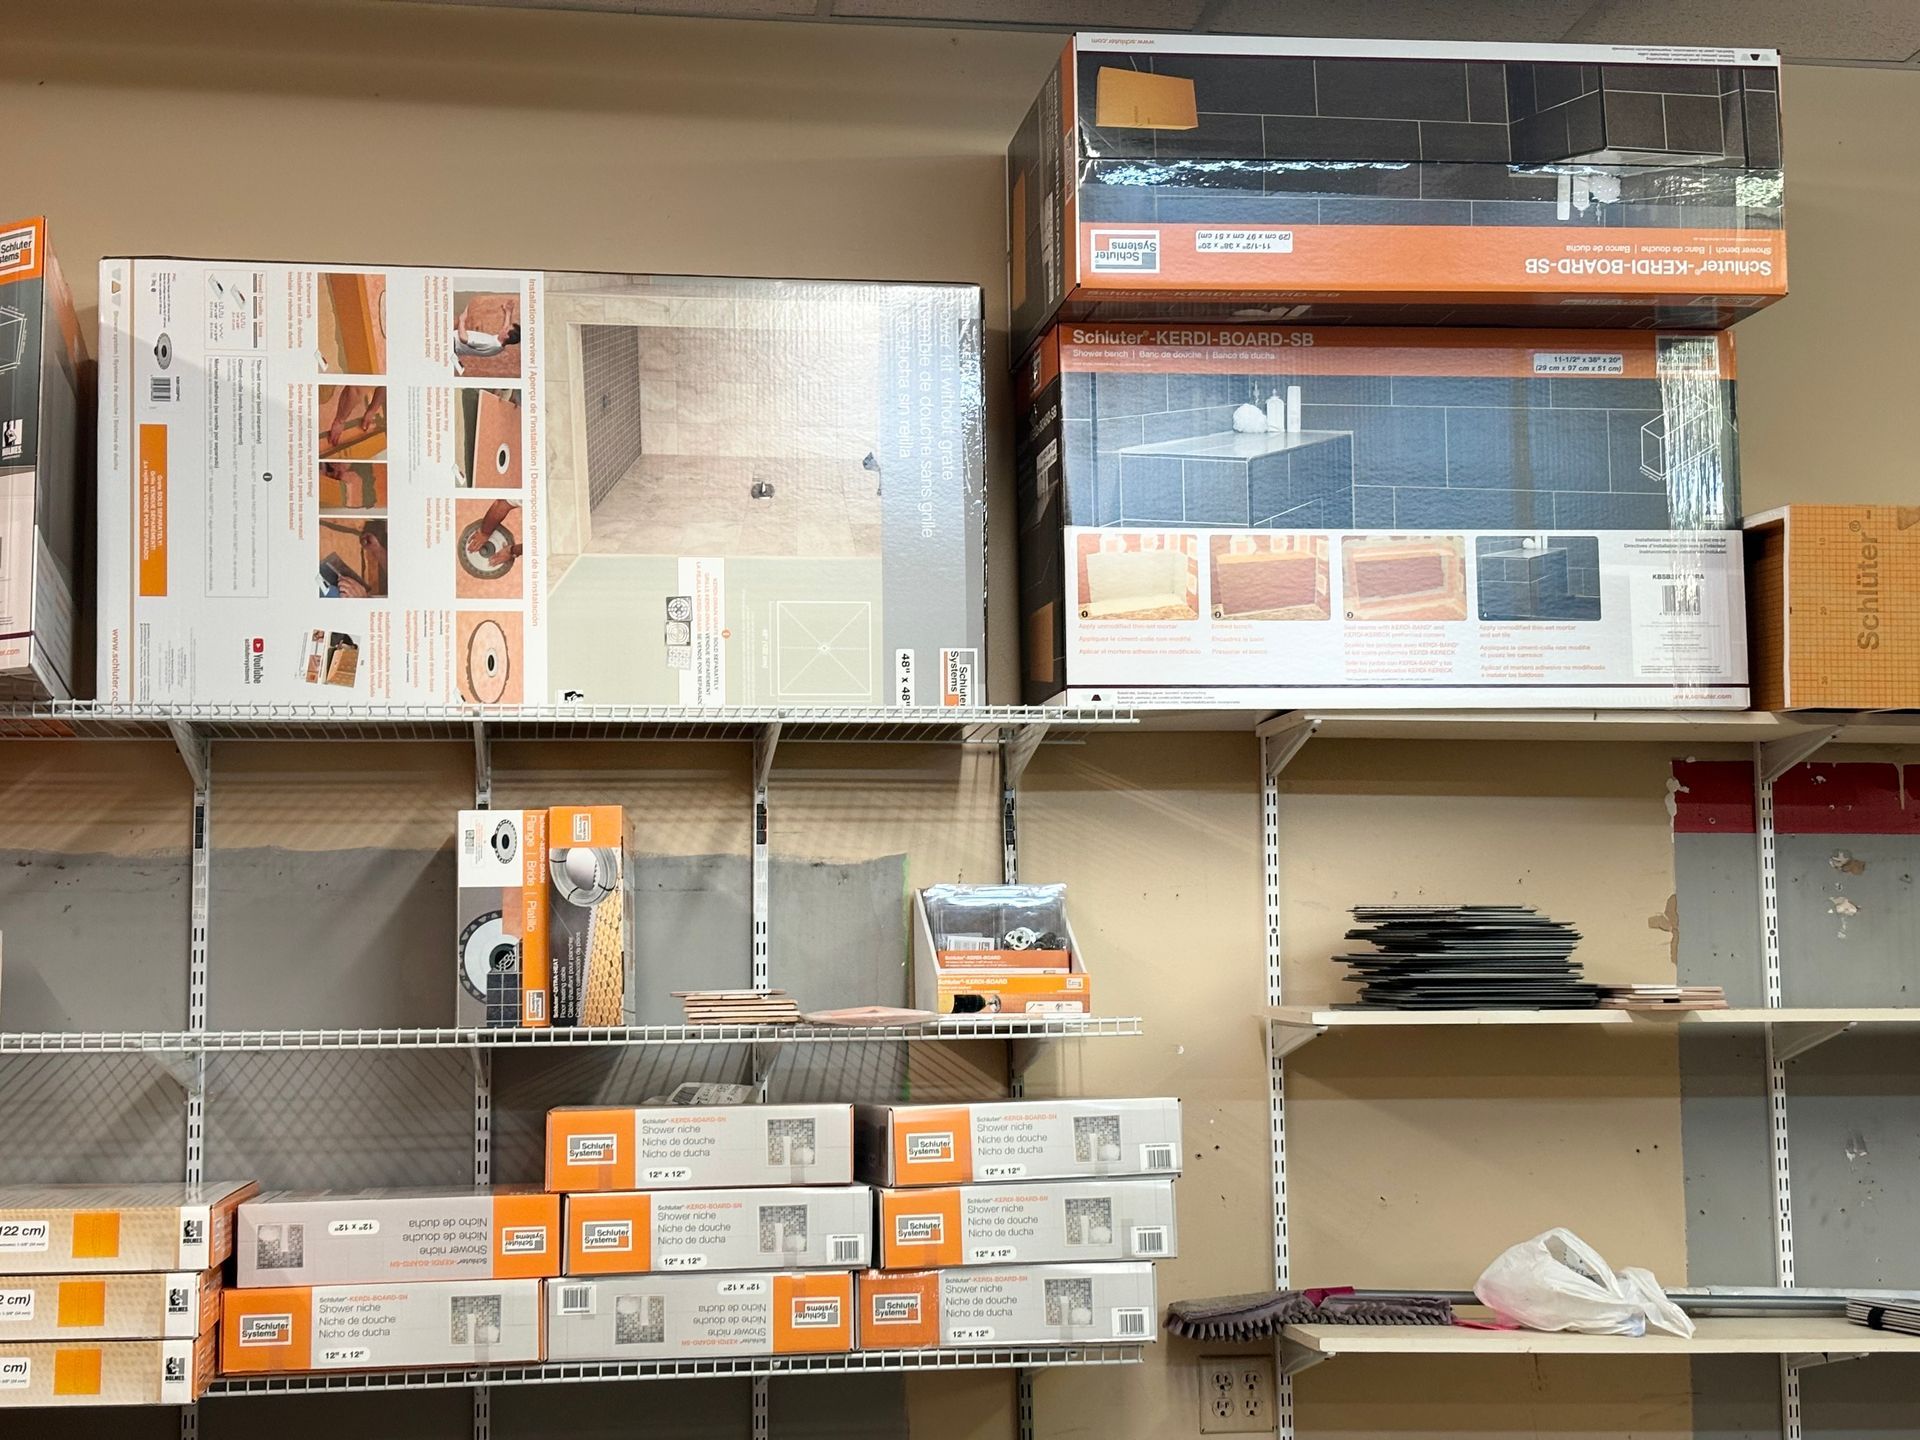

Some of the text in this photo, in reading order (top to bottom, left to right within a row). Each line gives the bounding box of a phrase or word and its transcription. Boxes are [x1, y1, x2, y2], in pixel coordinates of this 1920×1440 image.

[1090, 38, 1155, 47] www.schluter.com
[1198, 232, 1213, 240] cm)
[1, 241, 32, 253] Schluter
[1112, 241, 1156, 251] Systems
[1219, 242, 1234, 250] 38"
[1242, 242, 1271, 250] 11-1/2"
[1566, 245, 1591, 253] ducha
[1593, 245, 1603, 253] de
[1604, 245, 1630, 253] Banco
[1716, 246, 1740, 254] bench
[1741, 246, 1772, 255] Shower
[1095, 251, 1140, 261] Schluter
[1073, 350, 1102, 359] Shower
[1105, 350, 1128, 359] bench
[1139, 351, 1160, 359] Banc
[1161, 351, 1172, 359] de
[1173, 351, 1201, 359] douche
[1250, 352, 1275, 360] ducha
[899, 341, 913, 388] ducha
[940, 355, 957, 371] kit
[920, 371, 934, 391] de
[899, 394, 912, 415] sin
[941, 379, 956, 435] without
[920, 396, 933, 455] douche
[897, 421, 914, 458] rejilla
[528, 279, 539, 626] Installation overview Aperçu de l'installation Descripción general de la instalación
[936, 440, 956, 480] grate
[921, 460, 934, 497] sans
[917, 503, 935, 538] grille
[902, 653, 910, 674] 48"
[253, 654, 263, 684] YouTube
[950, 651, 959, 692] Systems
[525, 815, 537, 932] Flange Bride Platillo
[642, 1125, 700, 1134] Shower niche
[977, 1122, 1033, 1132] Shower niche
[642, 1136, 715, 1146] Niche de douche
[977, 1134, 1047, 1143] Niche de douche
[920, 1140, 950, 1148] Schluter
[569, 1150, 601, 1158] Systems
[642, 1149, 710, 1158] Nicho de ducha
[909, 1147, 940, 1156] Systems
[978, 1145, 1043, 1155] Nicho de ducha
[672, 1170, 685, 1178] 12"
[985, 1167, 999, 1175] 12"
[334, 1223, 349, 1232] 12"
[358, 1223, 373, 1231] 12"
[409, 1218, 487, 1230] Nicho de ducha
[910, 1222, 941, 1230] Schluter
[22, 1225, 45, 1238] cm)
[597, 1228, 629, 1236] Schluter
[898, 1229, 929, 1237] Systems
[402, 1232, 487, 1243] Niche de douche
[515, 1232, 544, 1241] Systems
[585, 1236, 617, 1244] Systems
[505, 1239, 533, 1247] Schluter
[419, 1245, 487, 1257] Shower niche
[7, 1294, 31, 1306] cm)
[807, 1304, 838, 1312] Systems
[887, 1301, 918, 1309] Schluter
[875, 1309, 907, 1317] Systems
[242, 1330, 276, 1339] Systems
[3, 1362, 27, 1374] cm)
